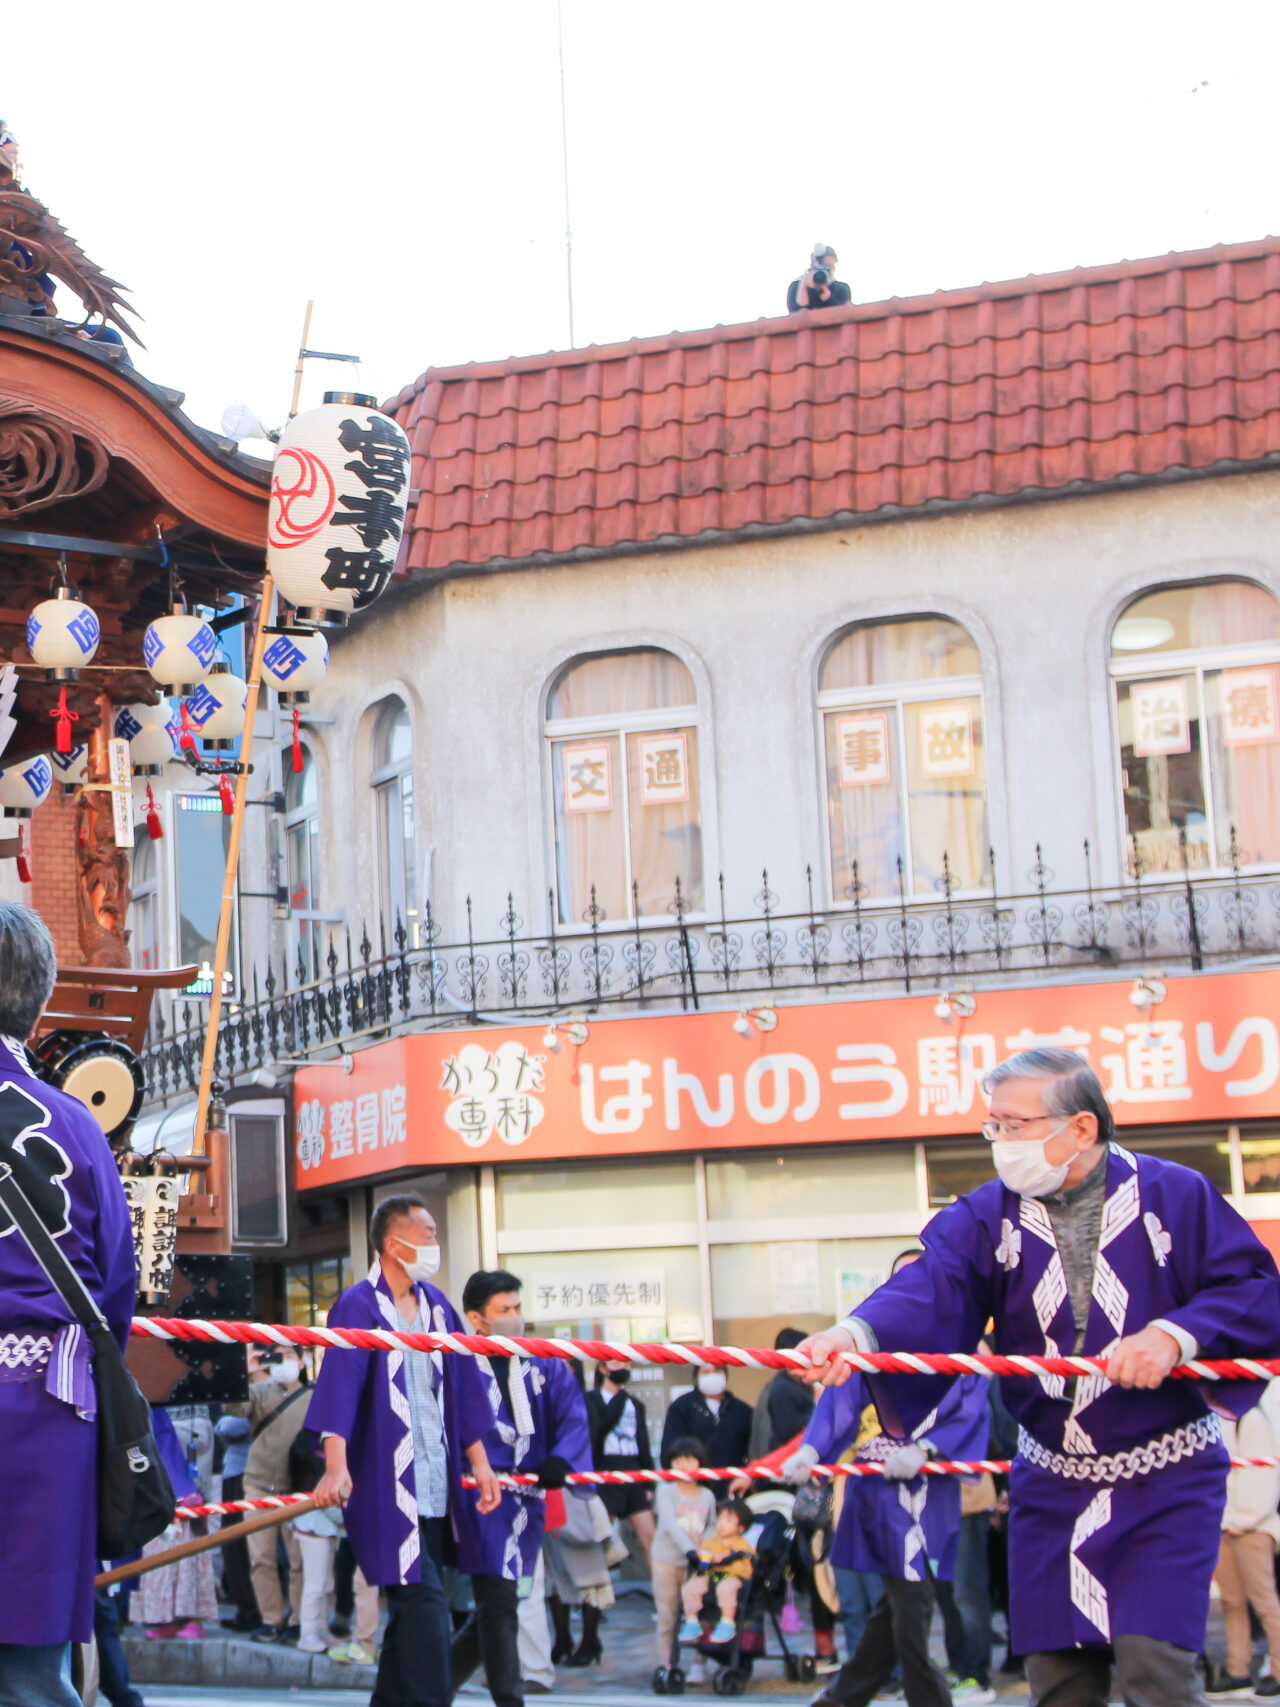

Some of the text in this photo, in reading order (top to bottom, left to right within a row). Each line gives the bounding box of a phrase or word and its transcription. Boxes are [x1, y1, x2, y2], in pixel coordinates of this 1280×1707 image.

[321, 415, 411, 609] 宮本町
[329, 1083, 407, 1160] 整骨院
[458, 1096, 533, 1140] 専科
[536, 1280, 662, 1309] 予約優先制
